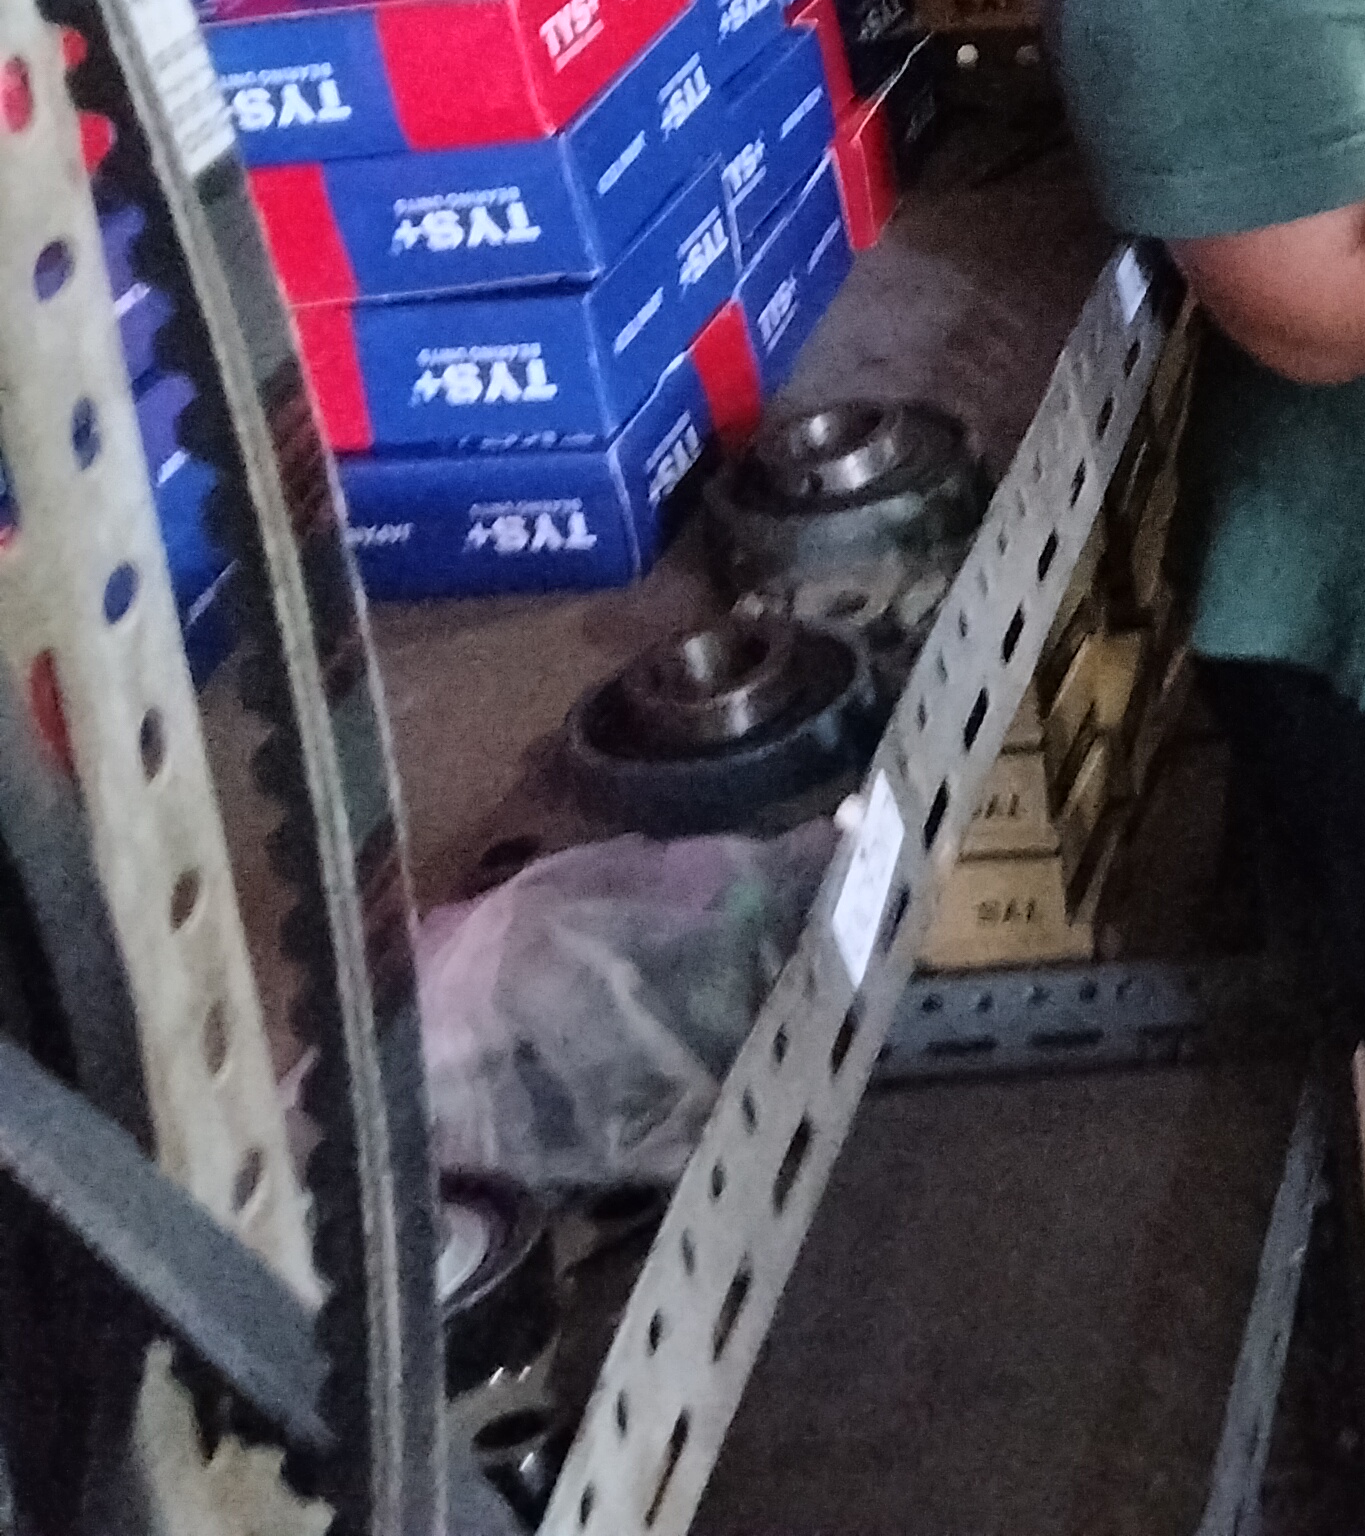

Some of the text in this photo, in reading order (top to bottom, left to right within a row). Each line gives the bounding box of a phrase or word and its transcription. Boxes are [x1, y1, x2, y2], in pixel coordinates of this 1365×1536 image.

[230, 78, 352, 132] TYS
[391, 200, 542, 254] TYS+
[409, 358, 559, 406] TYS+
[464, 511, 598, 554] TYS+
